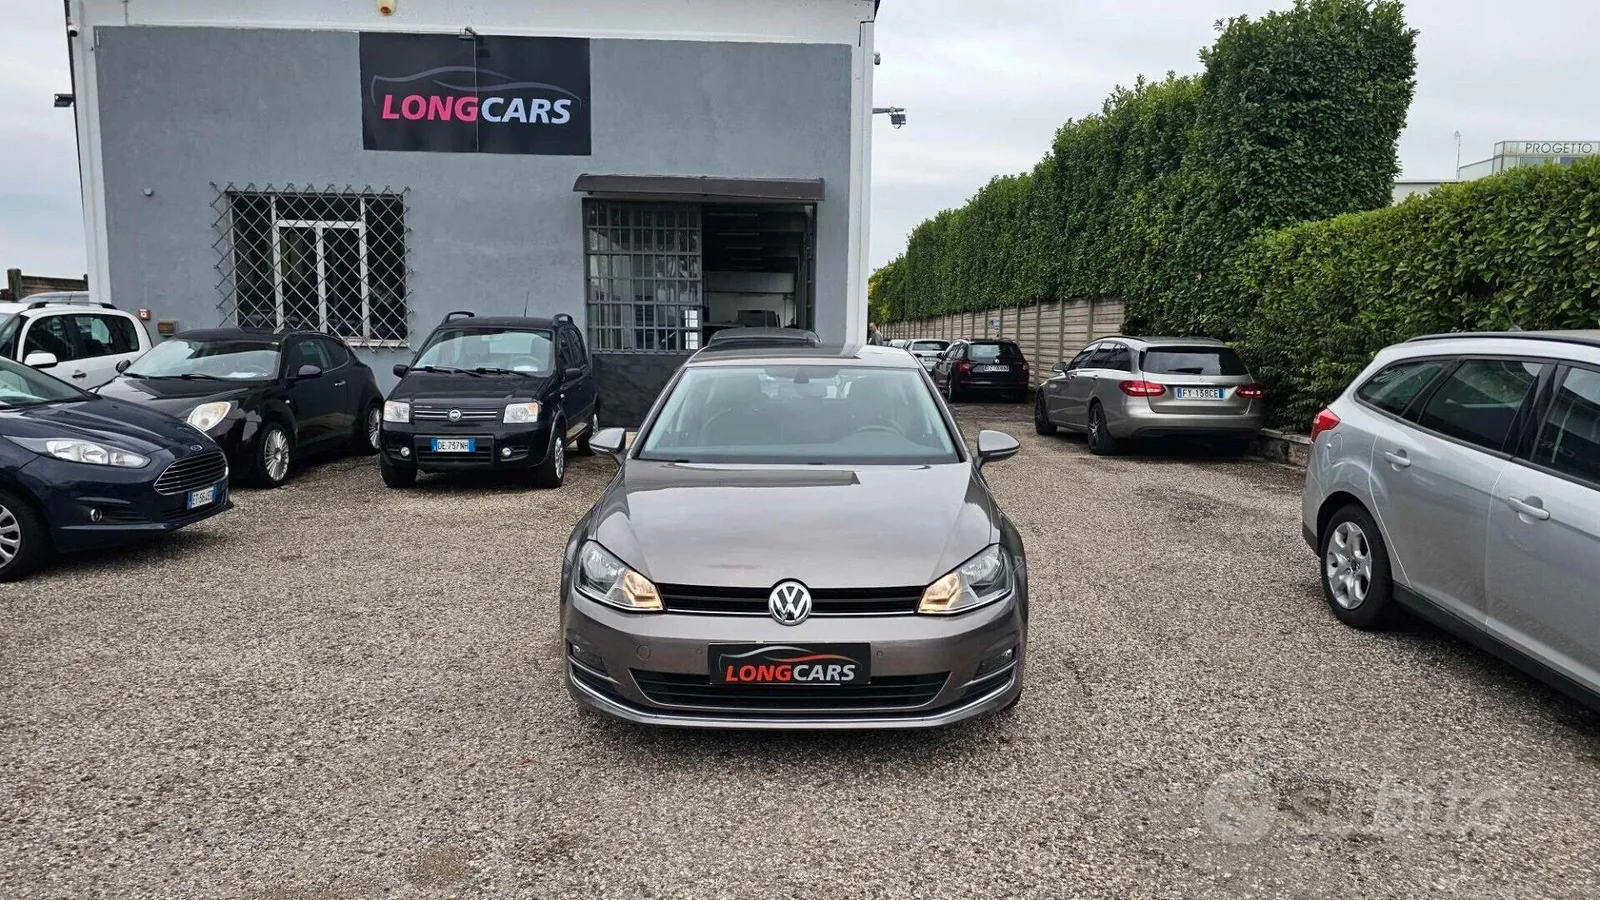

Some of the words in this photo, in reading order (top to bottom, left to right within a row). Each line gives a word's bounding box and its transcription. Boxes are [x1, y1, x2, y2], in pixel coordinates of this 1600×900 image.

[381, 94, 572, 124] LONGCARS
[1525, 142, 1593, 154] PROGETTO
[1182, 389, 1192, 398] FY
[726, 664, 856, 683] LONGCARS
